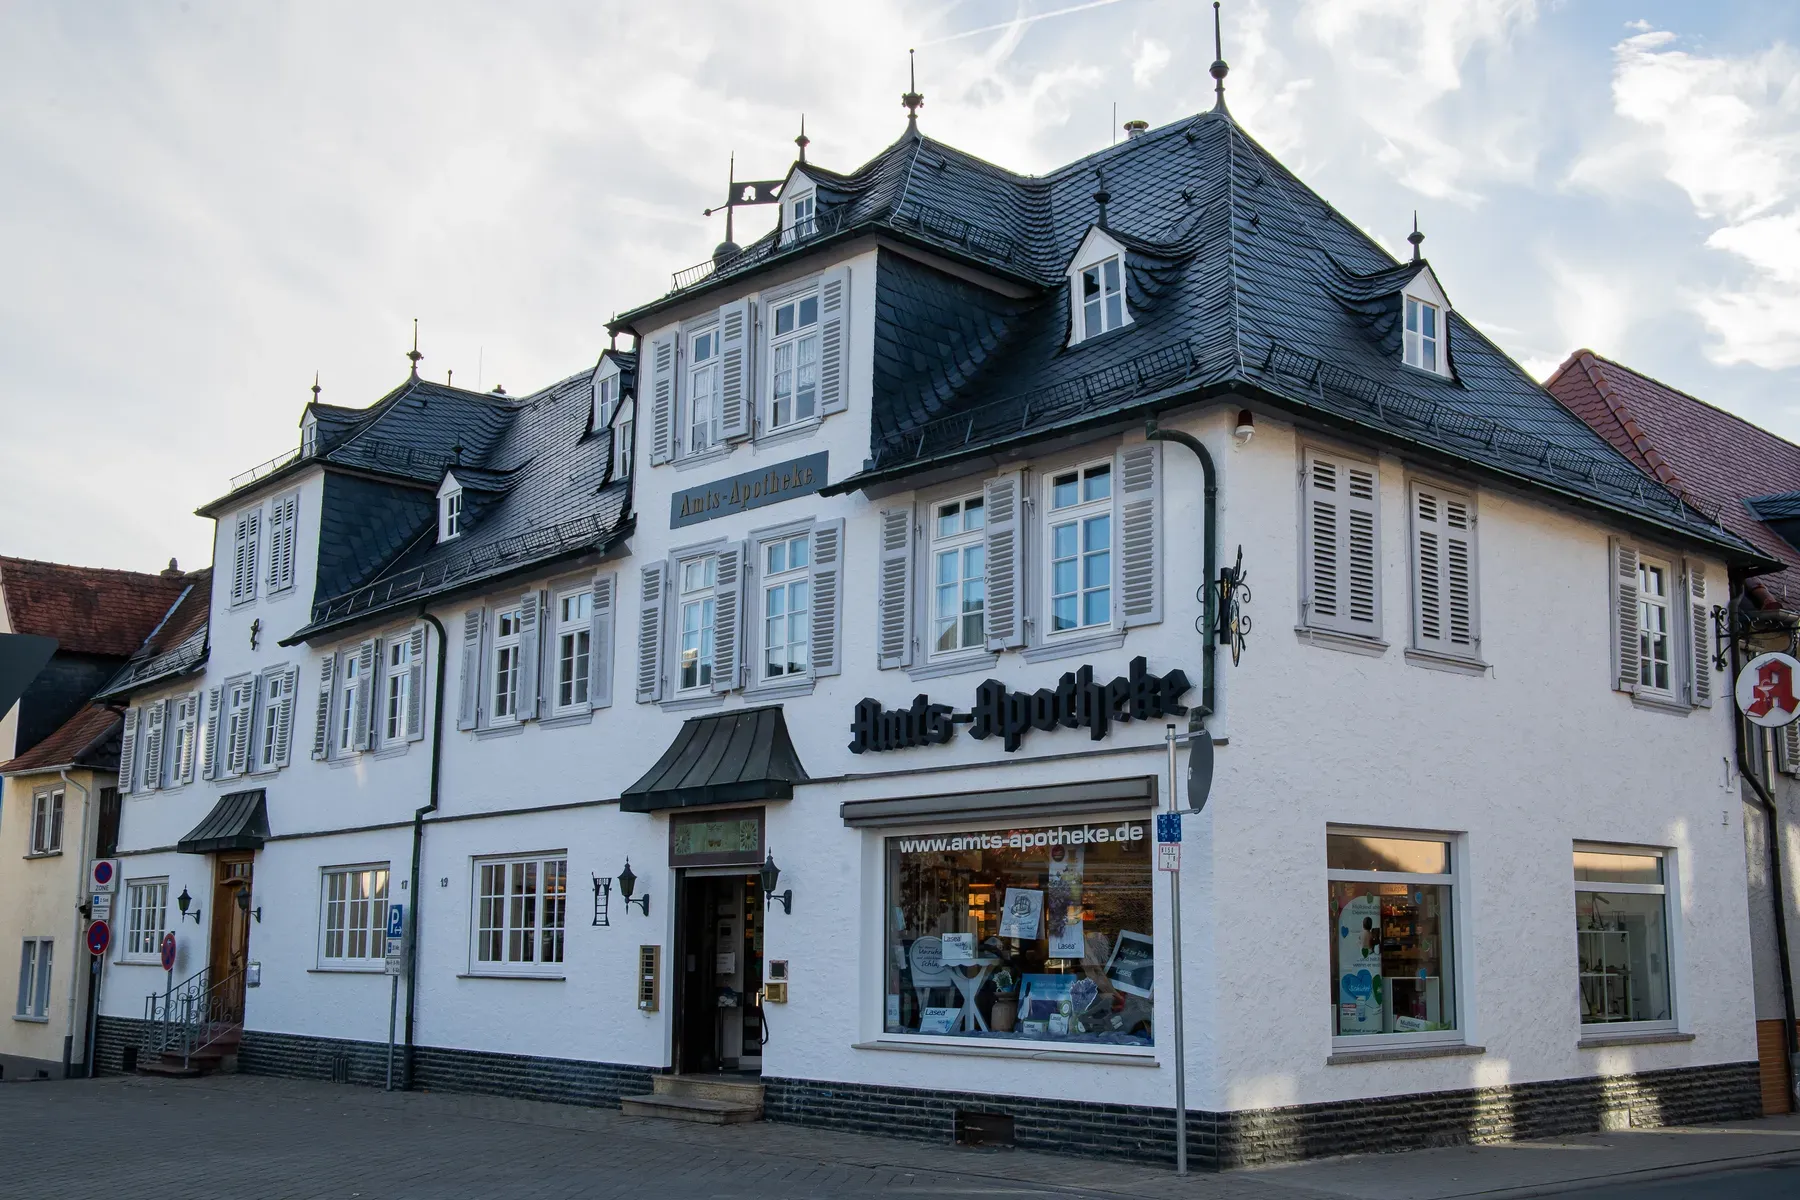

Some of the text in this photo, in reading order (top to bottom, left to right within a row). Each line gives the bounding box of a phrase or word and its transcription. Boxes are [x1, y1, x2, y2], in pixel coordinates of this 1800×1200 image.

[847, 655, 1193, 754] Amts-Apotheke
[900, 822, 1144, 853] www.amts-apotheke.de
[390, 908, 400, 934] P
